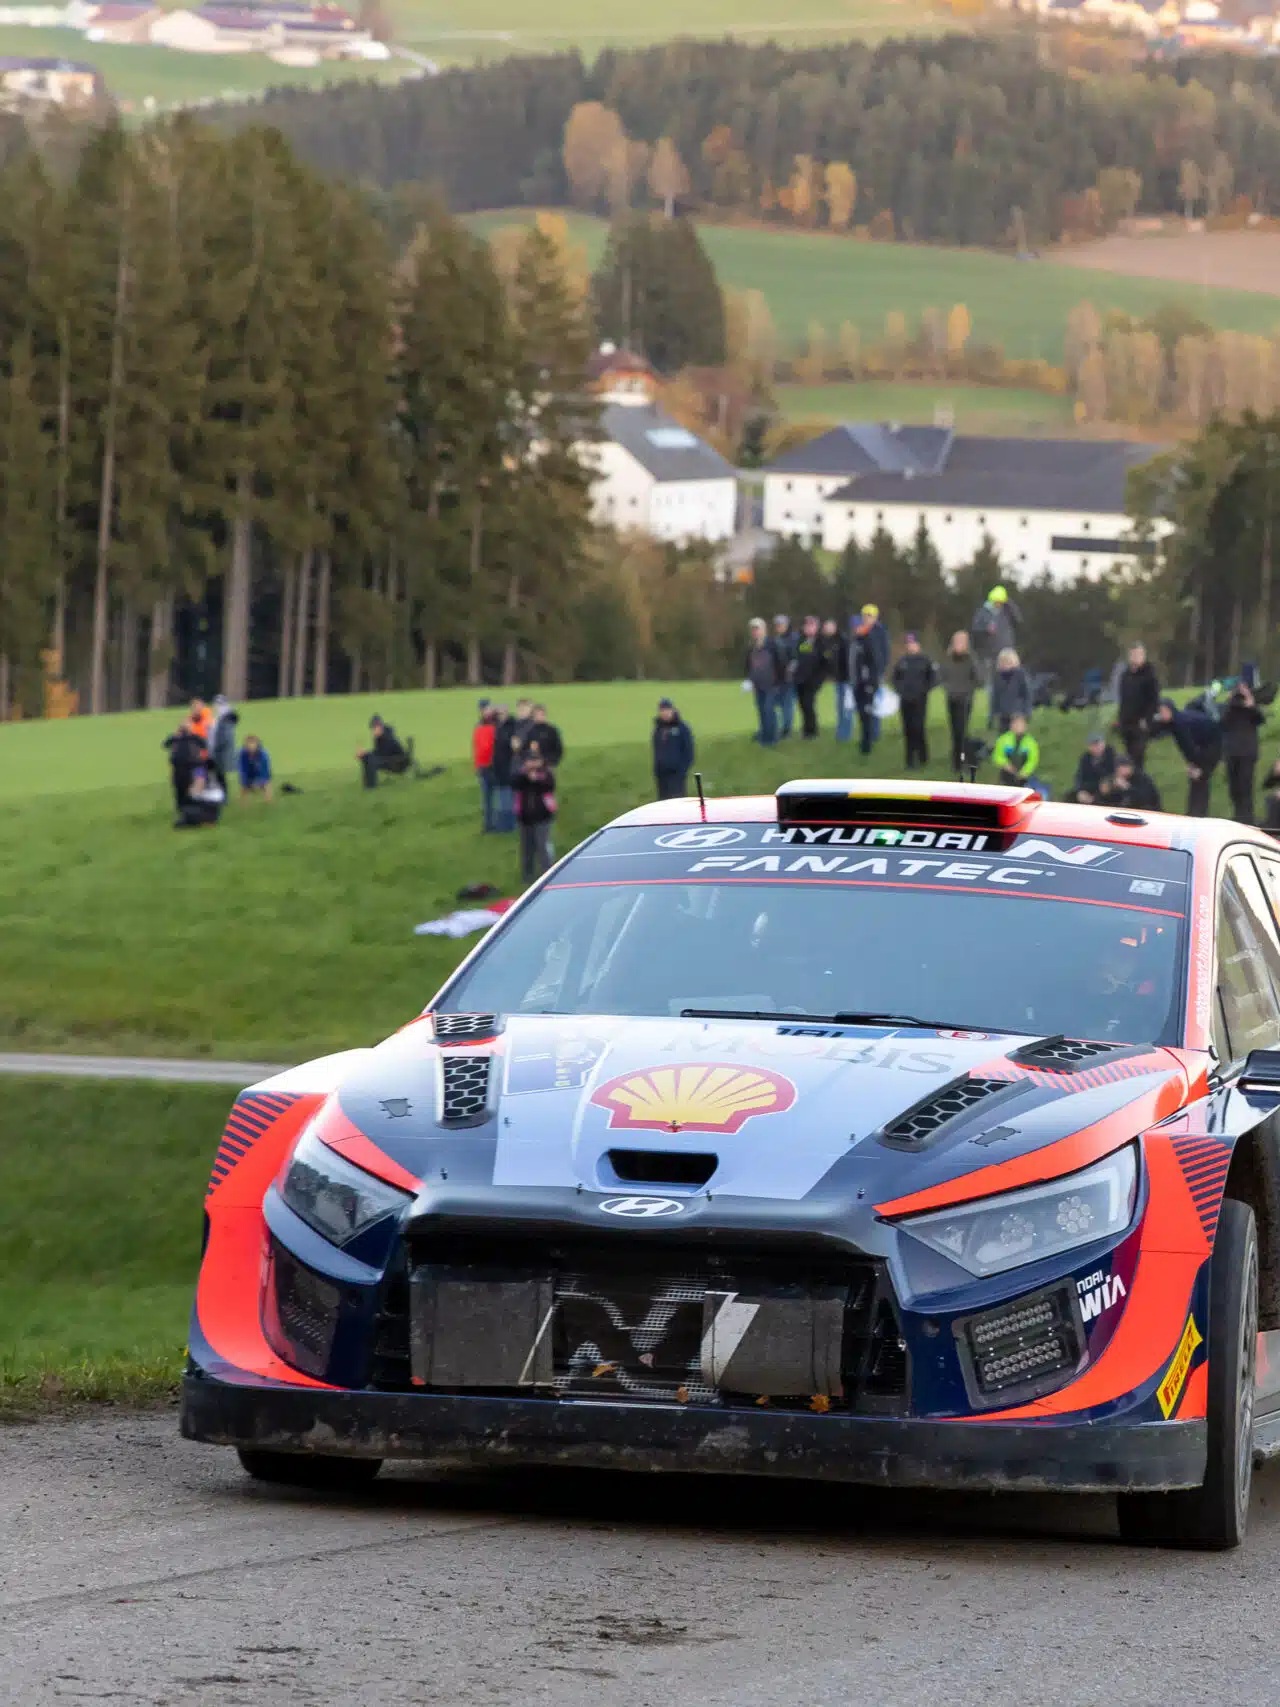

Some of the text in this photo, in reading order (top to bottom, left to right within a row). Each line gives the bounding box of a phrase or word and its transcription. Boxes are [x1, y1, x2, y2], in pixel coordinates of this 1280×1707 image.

[760, 827, 989, 851] HYUNDAI
[687, 855, 1044, 885] FANATEC
[1076, 1269, 1105, 1295] NDAI
